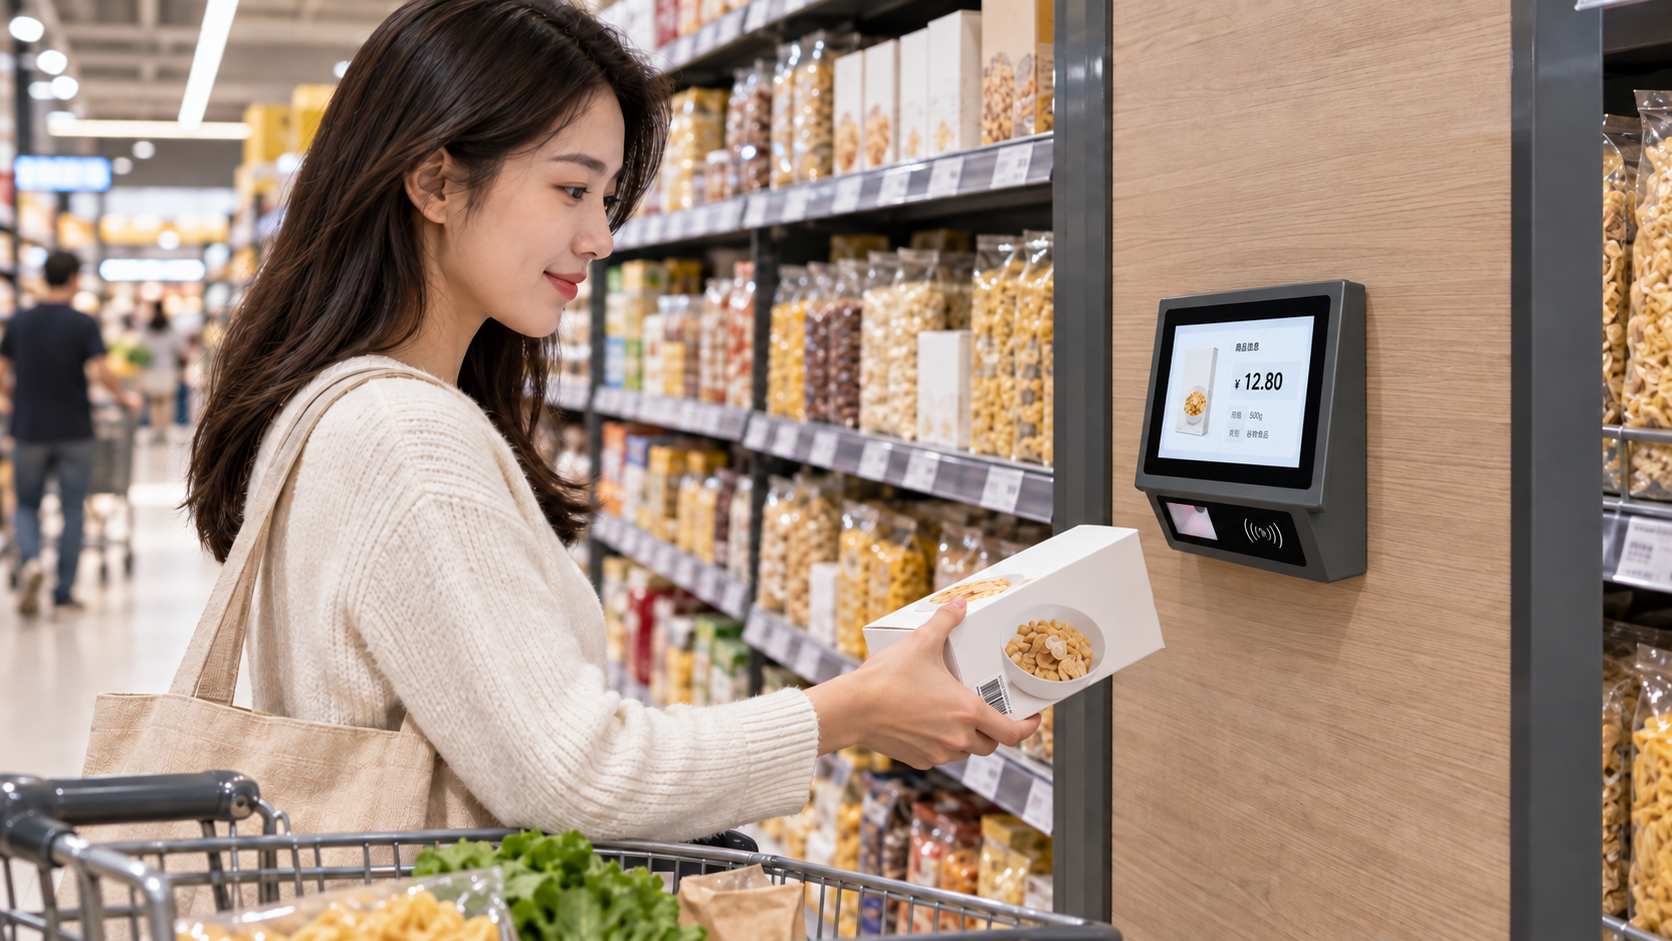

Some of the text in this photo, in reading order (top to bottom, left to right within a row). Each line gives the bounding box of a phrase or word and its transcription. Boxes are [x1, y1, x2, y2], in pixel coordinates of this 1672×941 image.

[1234, 371, 1283, 391] ¥ 12.80
[1249, 411, 1263, 421] 500g
